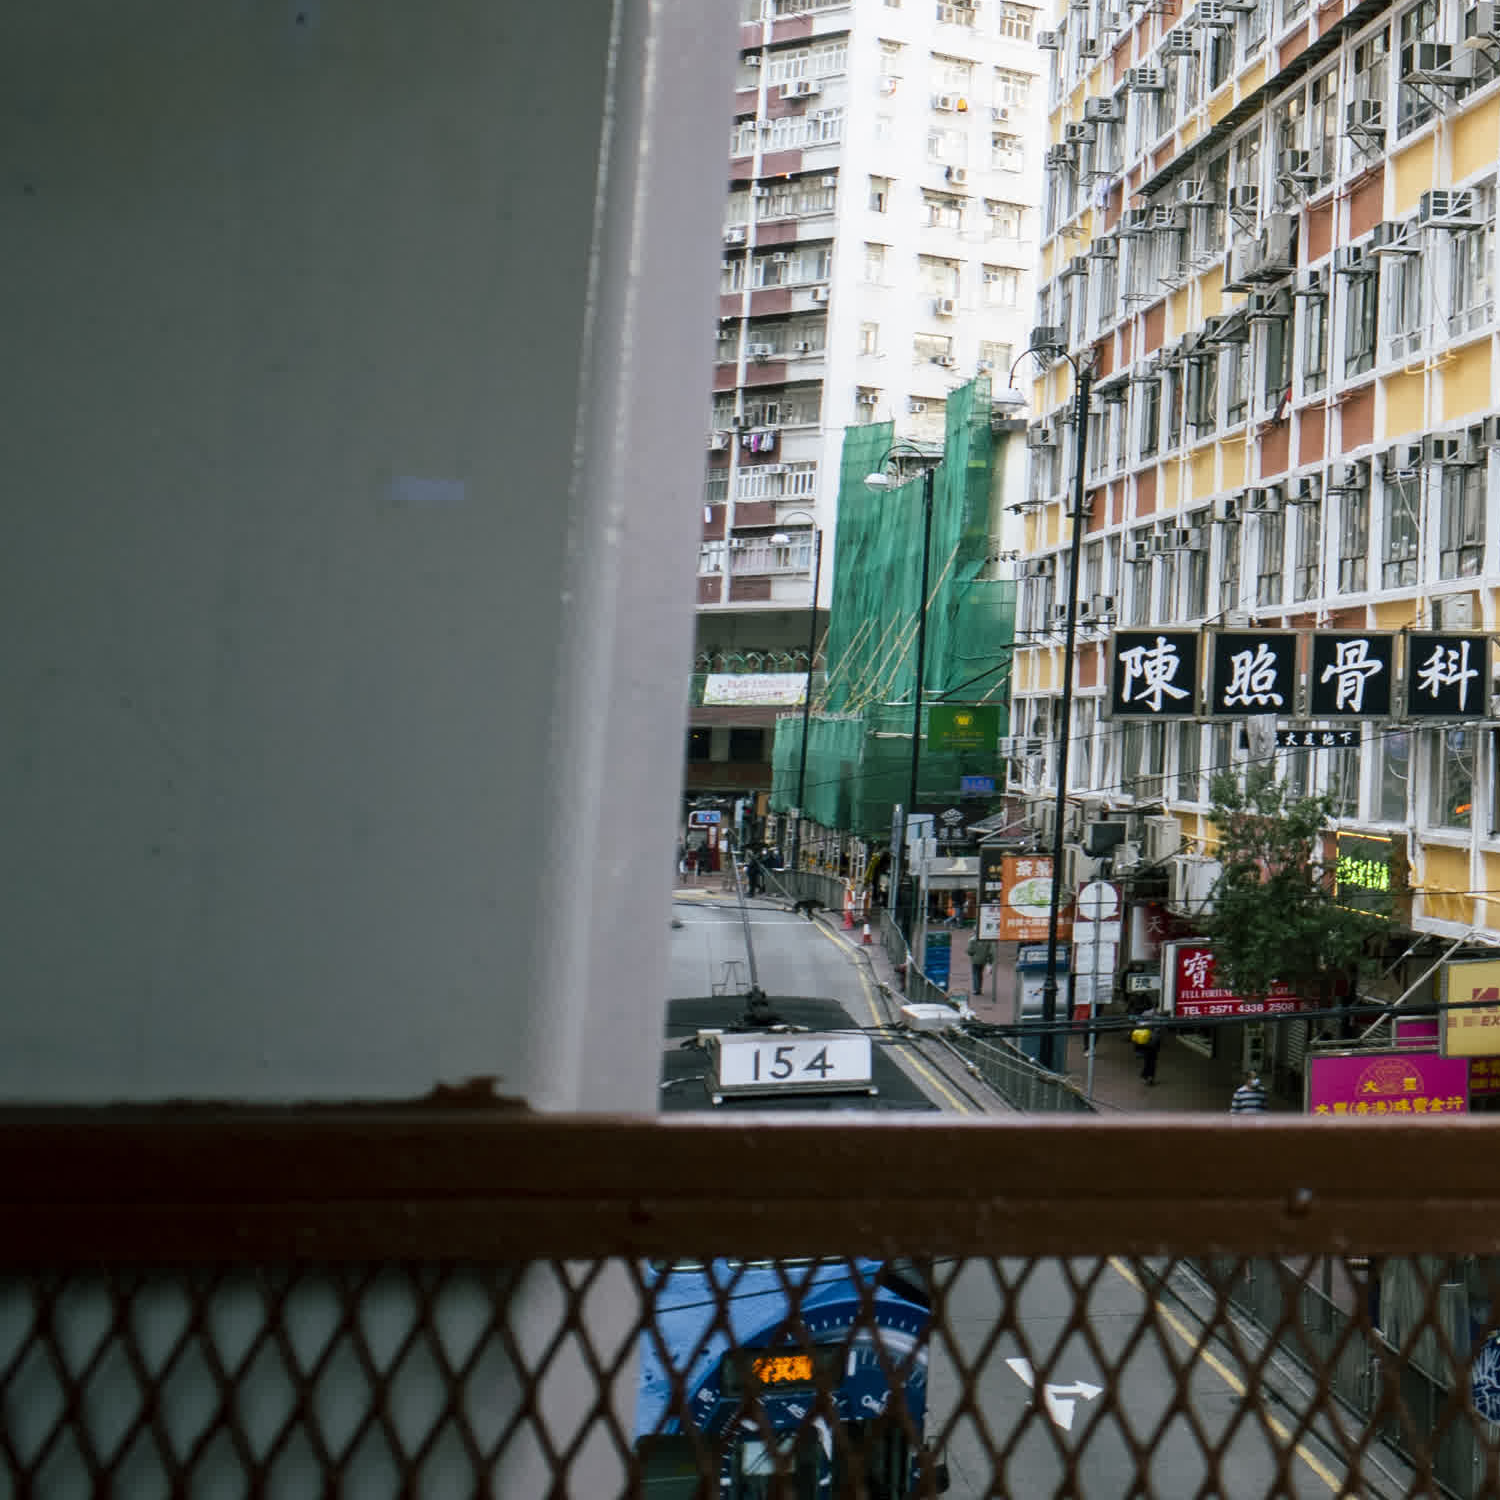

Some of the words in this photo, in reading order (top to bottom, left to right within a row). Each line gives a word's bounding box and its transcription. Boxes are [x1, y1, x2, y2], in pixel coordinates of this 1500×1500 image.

[1118, 636, 1479, 712] 陳照骨科
[1274, 731, 1352, 746] 大廈地下
[753, 1045, 835, 1081] 154
